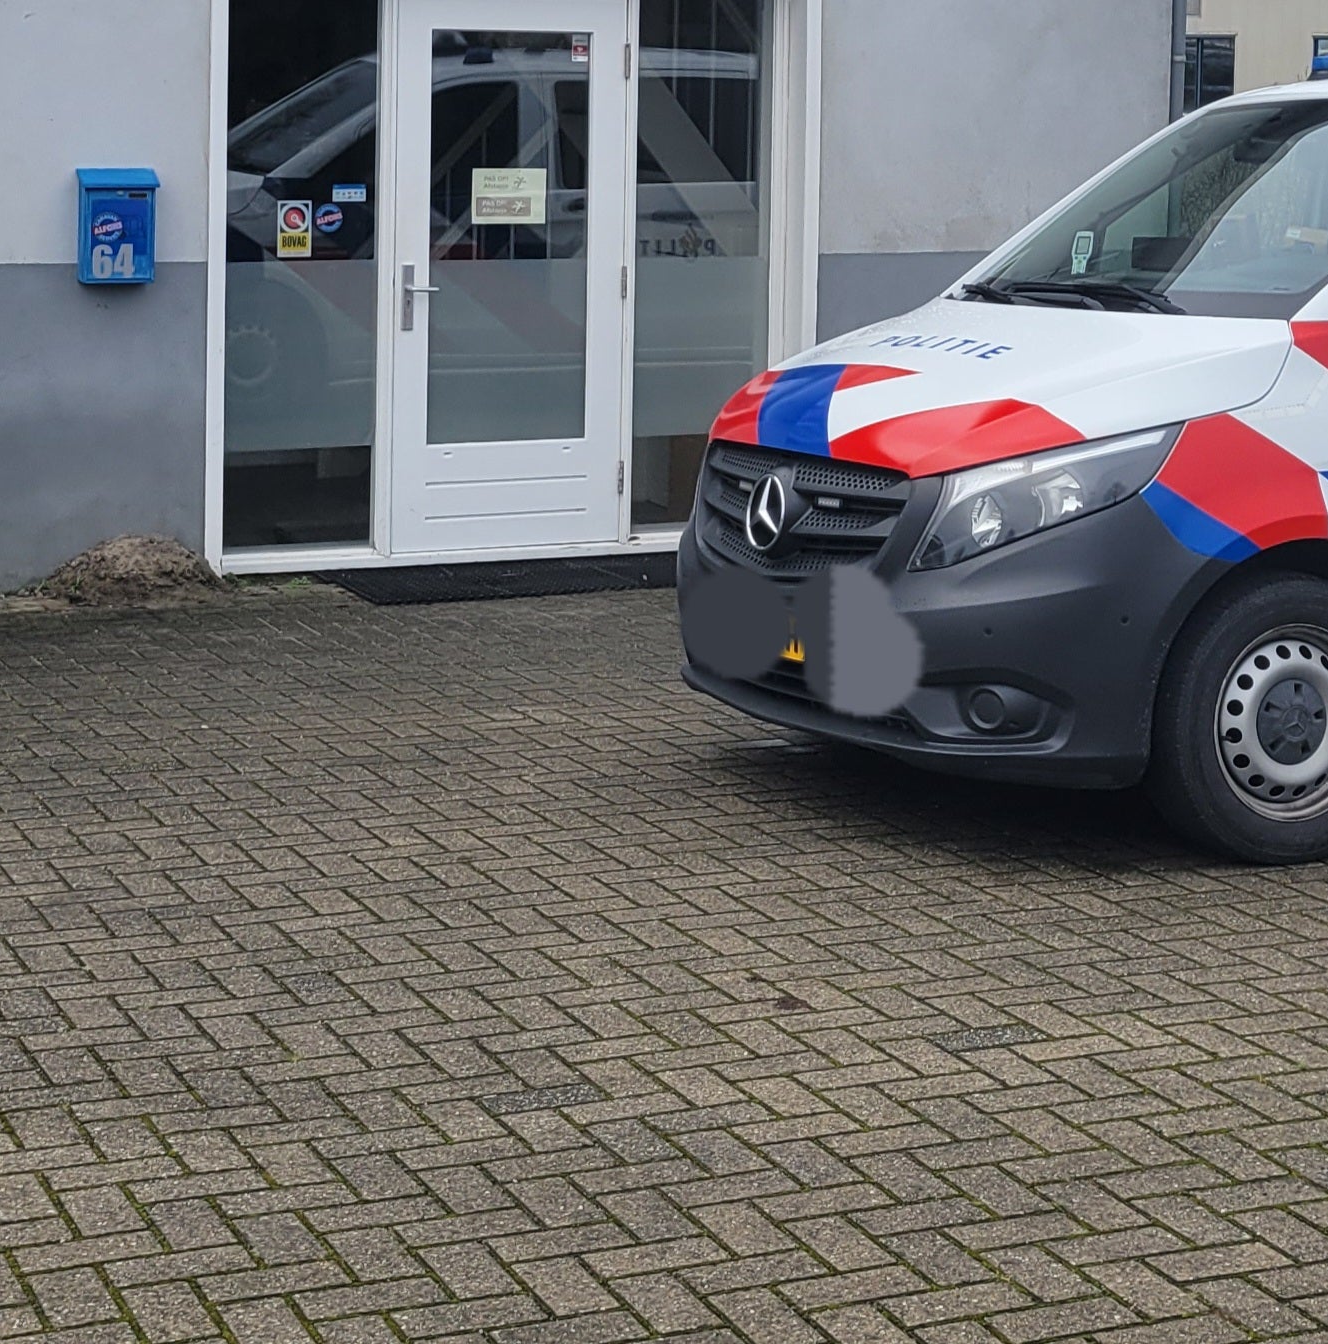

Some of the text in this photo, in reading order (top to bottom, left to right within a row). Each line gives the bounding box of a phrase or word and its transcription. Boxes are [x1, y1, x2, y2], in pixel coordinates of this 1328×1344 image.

[282, 235, 307, 248] BOVAG
[92, 243, 135, 279] 64
[869, 335, 1014, 360] POLITIE
